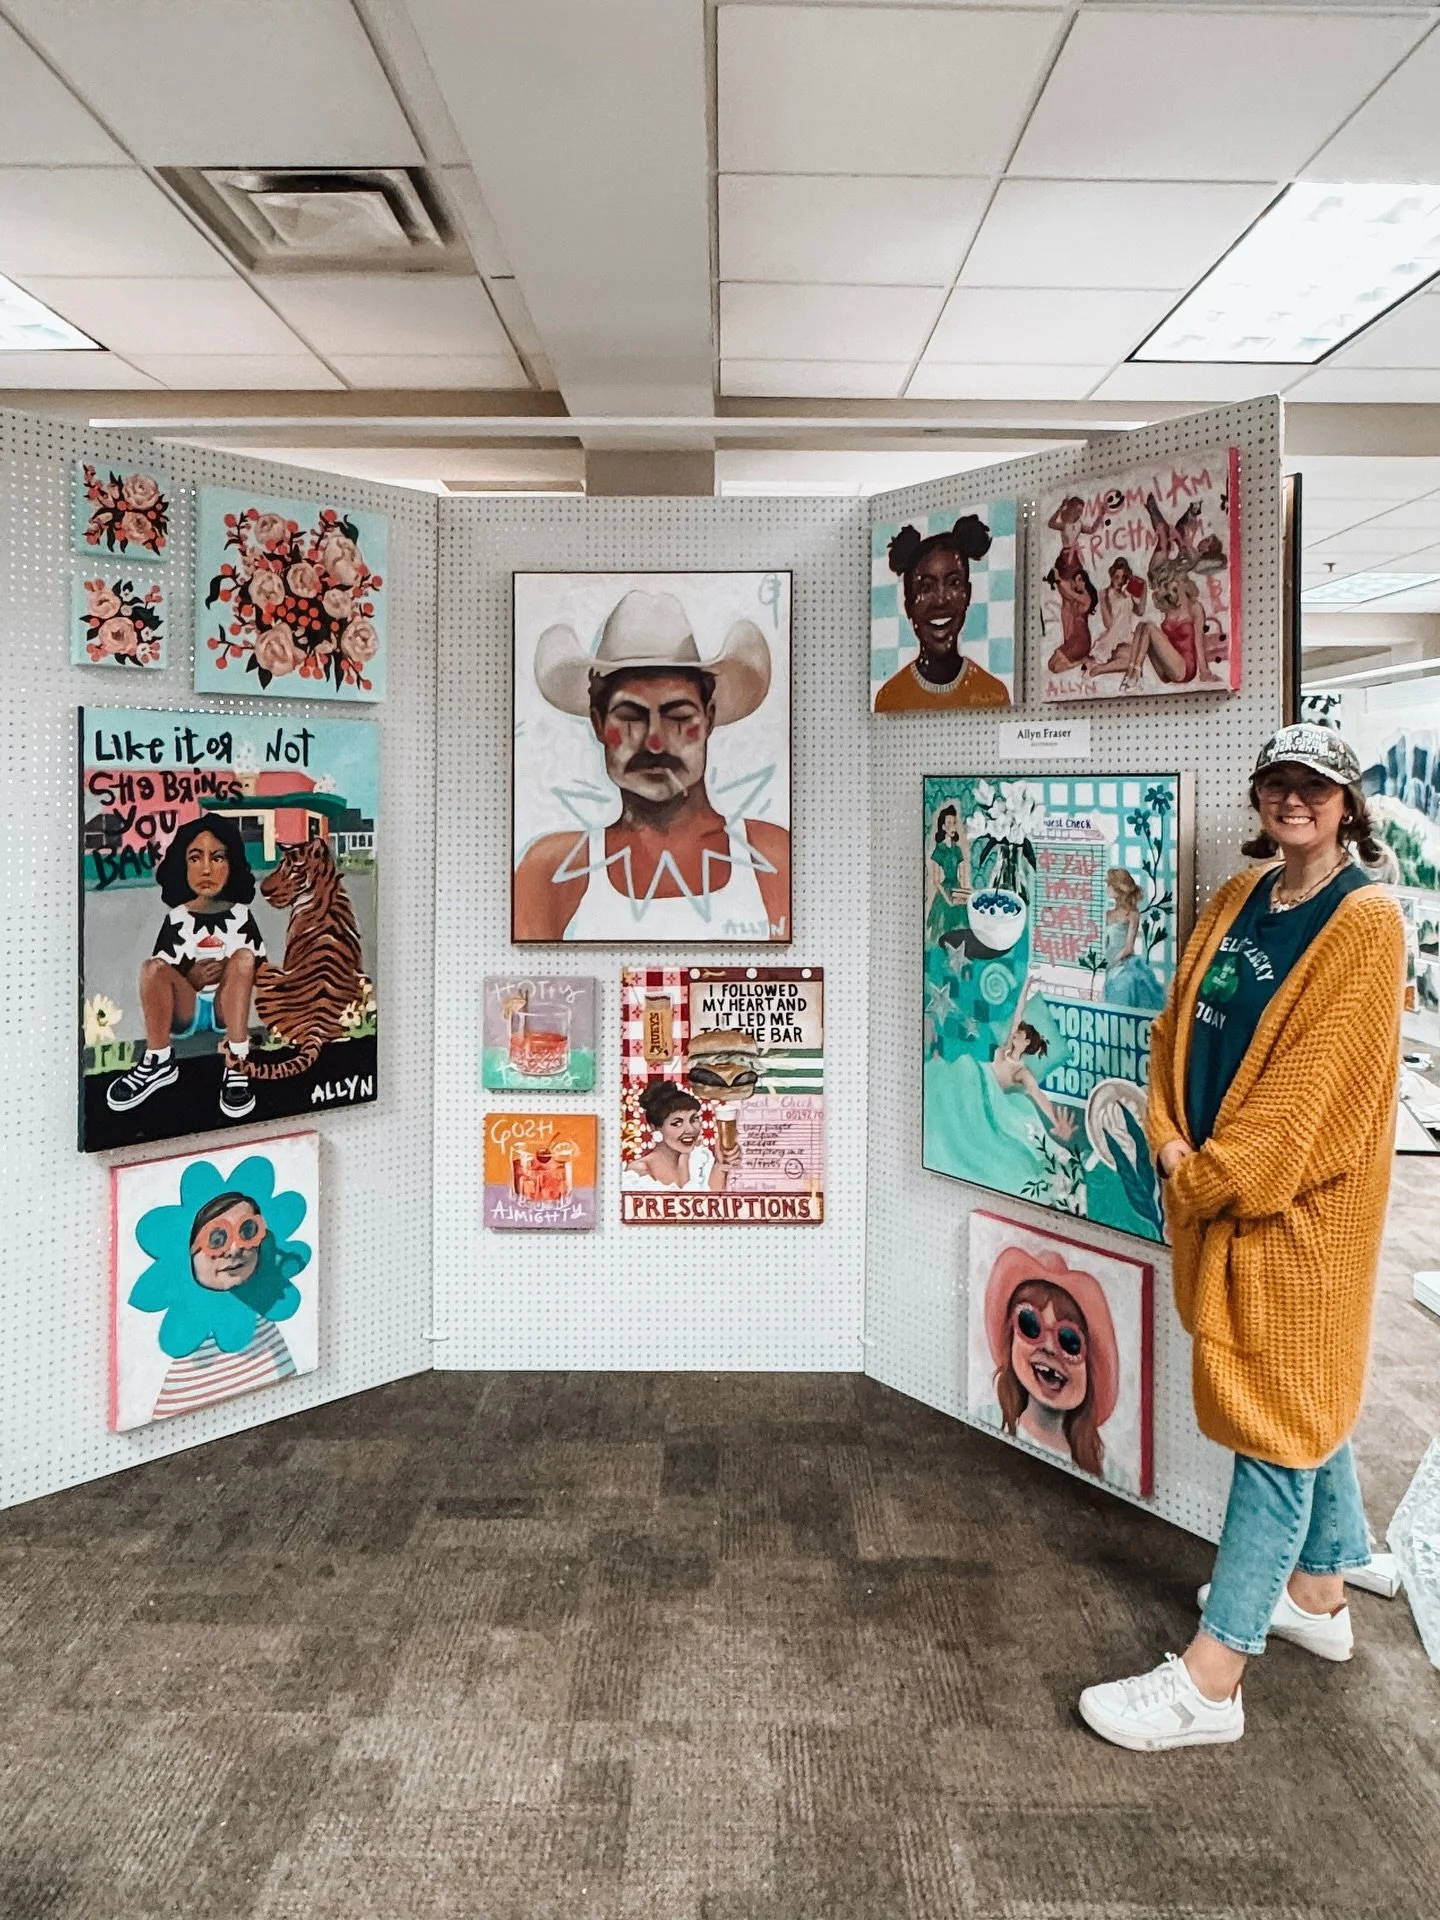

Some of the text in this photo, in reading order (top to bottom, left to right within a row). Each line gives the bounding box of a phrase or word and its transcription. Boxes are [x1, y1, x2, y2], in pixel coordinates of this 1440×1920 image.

[1017, 728, 1072, 740] Allyn Fraser
[112, 804, 177, 840] YOU
[721, 983, 799, 998] FOLLOWED
[702, 997, 807, 1013] MY HEART AND
[715, 1012, 794, 1027] IT LED ME
[770, 1026, 803, 1043] BAR
[311, 1074, 373, 1104] ALLYN
[633, 1196, 811, 1221] PRESCRIPTIONS
